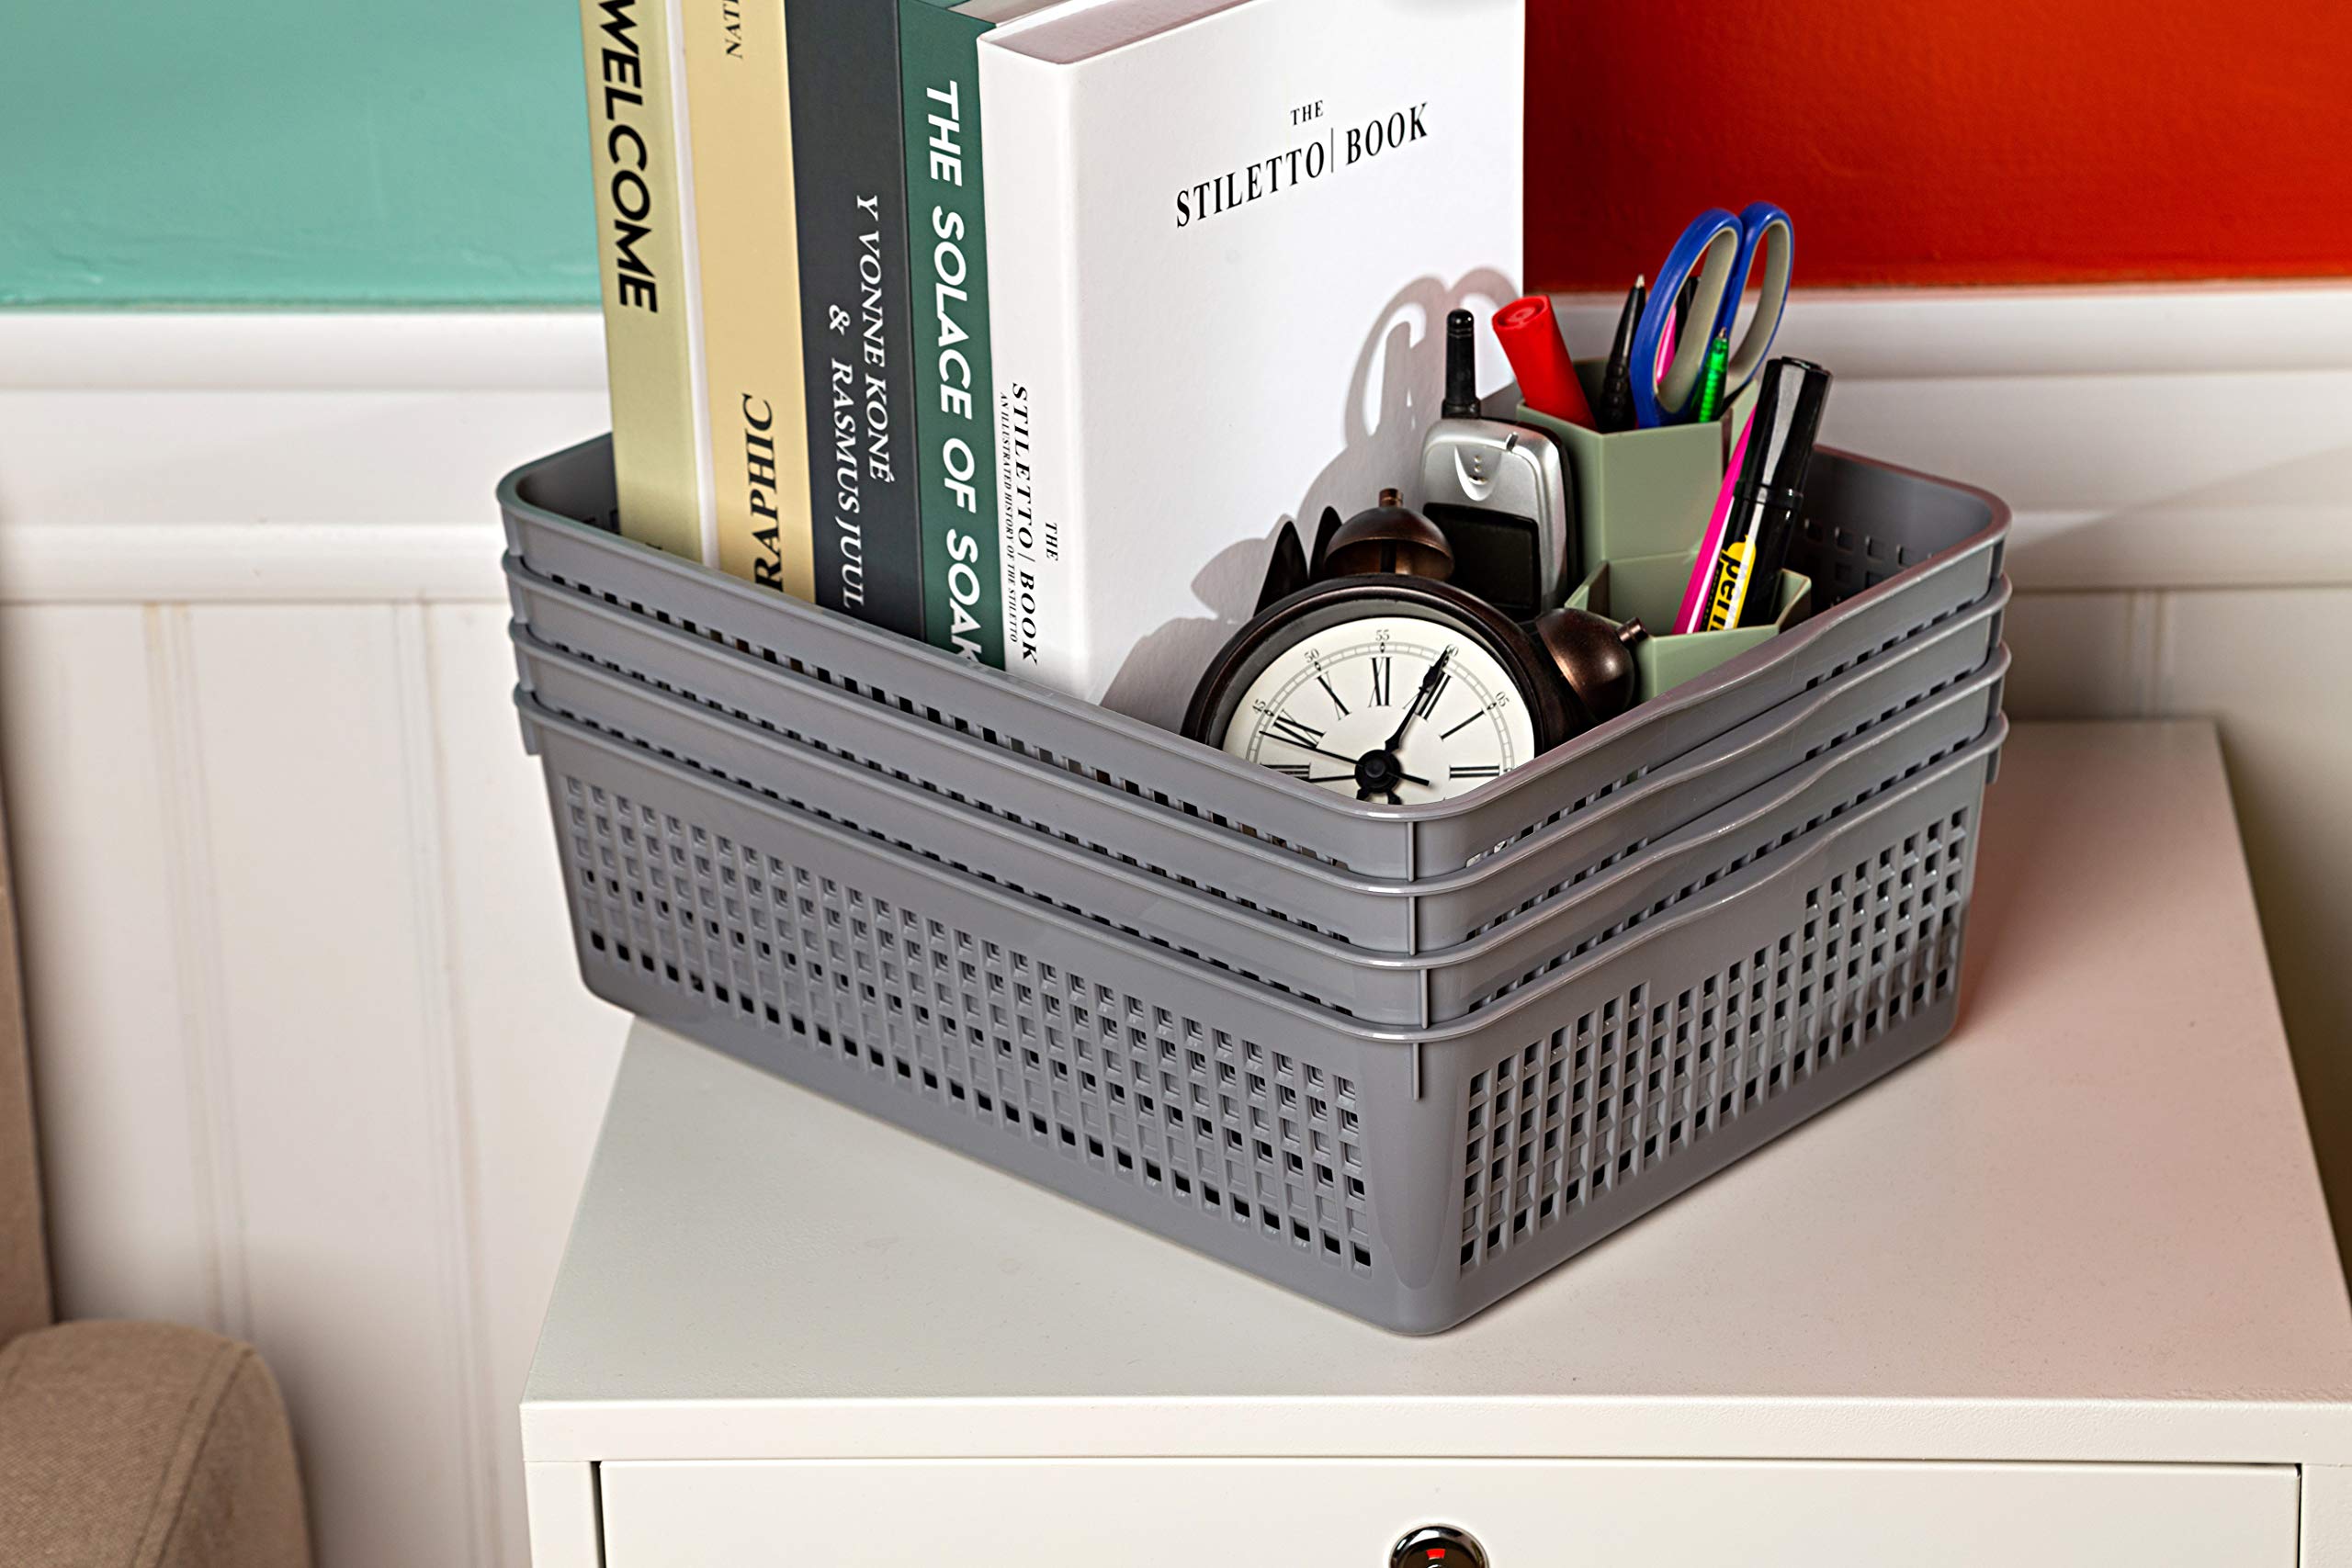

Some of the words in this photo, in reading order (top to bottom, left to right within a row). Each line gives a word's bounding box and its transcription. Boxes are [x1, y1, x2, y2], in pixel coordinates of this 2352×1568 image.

[722, 0, 742, 60] NAT
[926, 80, 963, 187] THE
[1290, 99, 1324, 126] THE
[597, 0, 658, 313] WELCOME
[1176, 141, 1325, 229] STILETTO
[1345, 102, 1429, 166] BOOK
[829, 304, 851, 336] &
[932, 205, 973, 421] SOLACE
[865, 372, 896, 483] KONÉ
[1000, 392, 1010, 410] AN
[831, 357, 861, 514] RASMUS
[1001, 411, 1012, 491] ILLUSTRATED
[943, 437, 977, 514] OF
[1012, 381, 1034, 549] STILETTO
[1004, 491, 1014, 544] HISTORY
[1045, 522, 1059, 562] THE
[835, 515, 865, 610] JUUL
[1006, 545, 1015, 561] OF
[1007, 563, 1016, 587] THE
[1008, 587, 1019, 643] STILETTO
[1019, 570, 1038, 666] BOOK
[1375, 628, 1390, 641] 55
[1303, 648, 1320, 663] 50
[1367, 656, 1393, 708] XI
[1252, 698, 1267, 715] 45
[1314, 671, 1351, 721] X
[1495, 691, 1510, 707] 05
